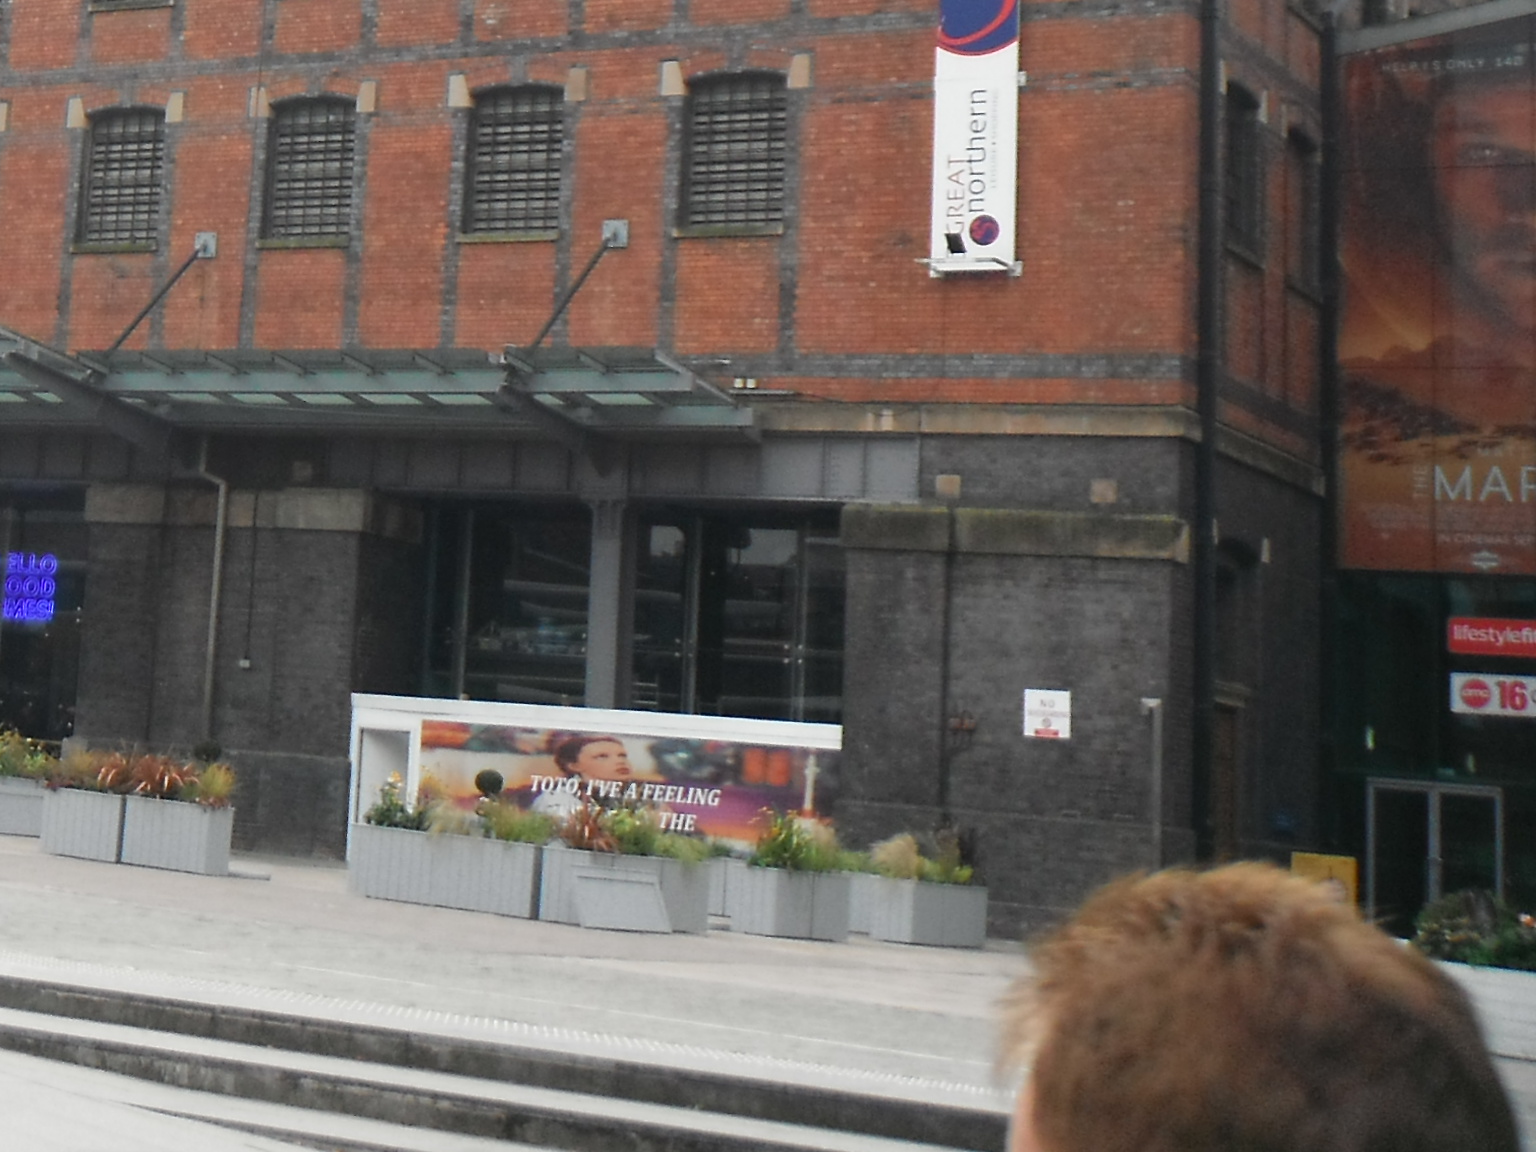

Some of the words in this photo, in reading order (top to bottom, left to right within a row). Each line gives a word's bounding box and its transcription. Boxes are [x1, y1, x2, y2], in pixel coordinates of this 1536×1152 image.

[966, 89, 988, 212] northern
[947, 156, 967, 235] GREAT
[1453, 624, 1536, 646] lifestylefi
[1495, 680, 1528, 711] 16
[530, 774, 582, 797] TOTO,
[585, 778, 622, 798] I'VE
[624, 781, 640, 800] A
[642, 783, 721, 806] FEELING
[658, 811, 697, 832] THE
